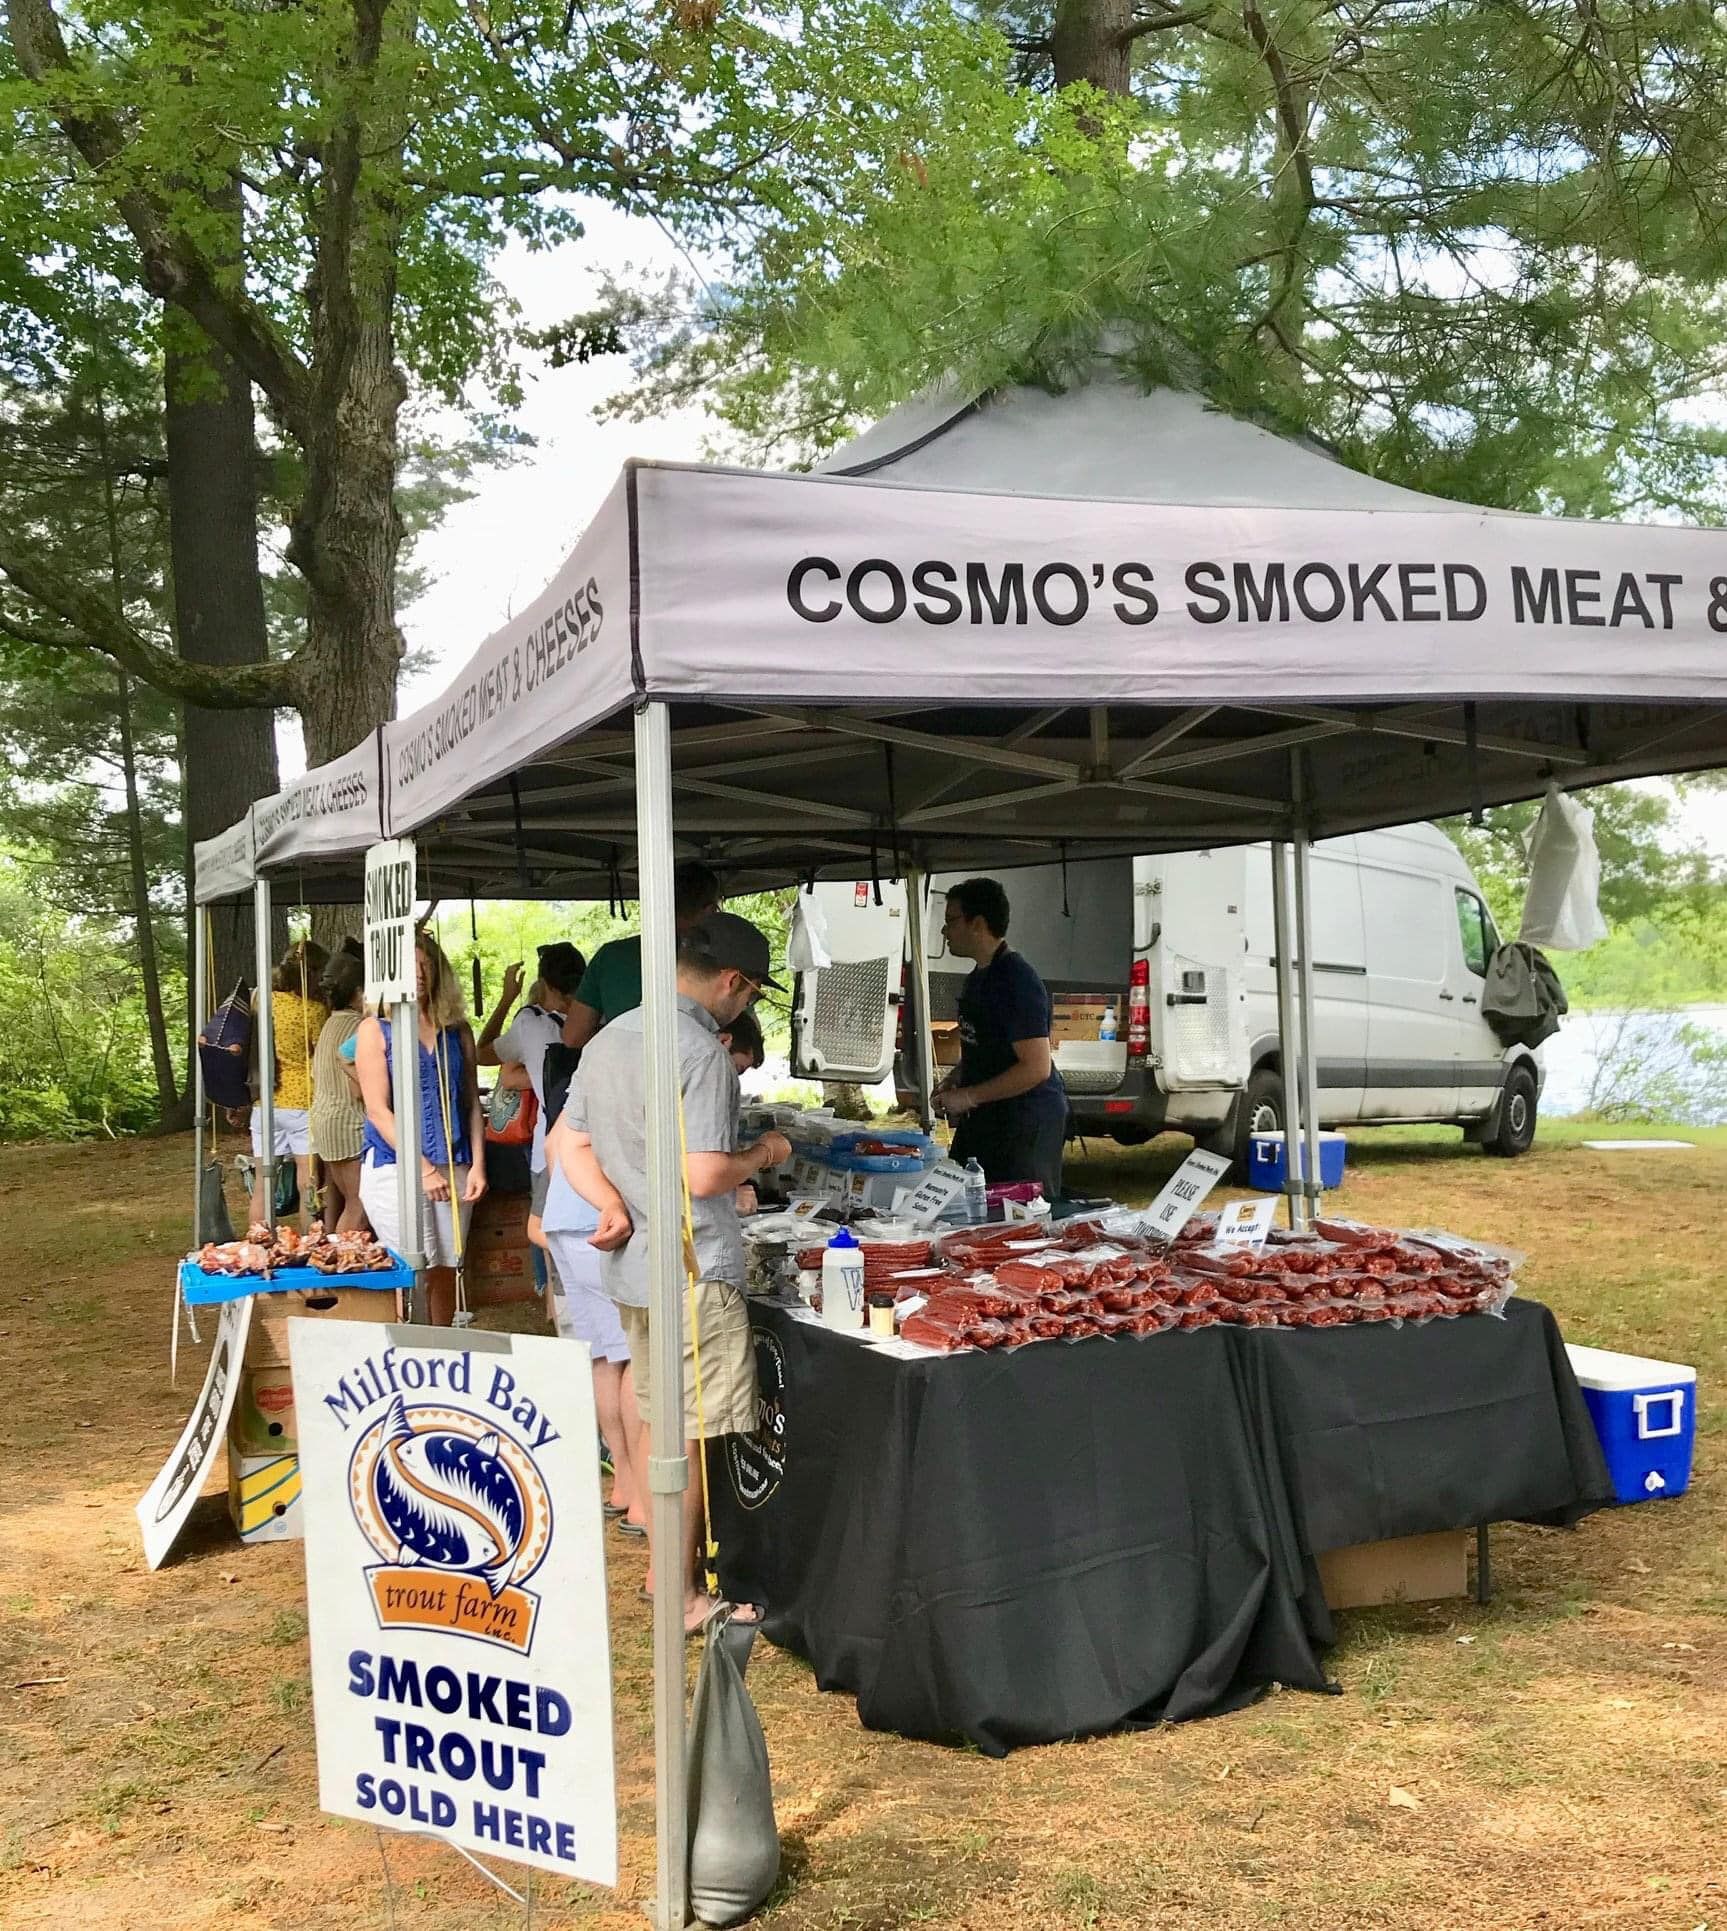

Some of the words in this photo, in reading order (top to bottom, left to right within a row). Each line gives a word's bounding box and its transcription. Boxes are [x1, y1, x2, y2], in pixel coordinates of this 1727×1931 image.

[787, 556, 1159, 625] COSMO'S
[1184, 561, 1488, 624] SMOKED
[1510, 565, 1684, 630] MEAT
[435, 684, 477, 761] SMOKED
[478, 656, 509, 726] MEAT
[512, 647, 521, 702] &
[525, 576, 604, 692] CHEESES
[327, 770, 368, 814] CHEESES
[366, 860, 412, 925] SMOKED
[370, 924, 405, 983] TROUT
[1160, 1203, 1178, 1222] USE
[1171, 1178, 1200, 1201] PLEASE
[323, 1347, 473, 1432] Milford
[485, 1364, 562, 1452] Bay
[385, 1585, 446, 1612] trout
[450, 1582, 518, 1628] farm
[484, 1623, 516, 1643] inc.
[348, 1649, 573, 1737] SMOKED
[374, 1715, 547, 1800] TROUT
[355, 1772, 458, 1829] SOLD
[472, 1799, 577, 1862] HERE
